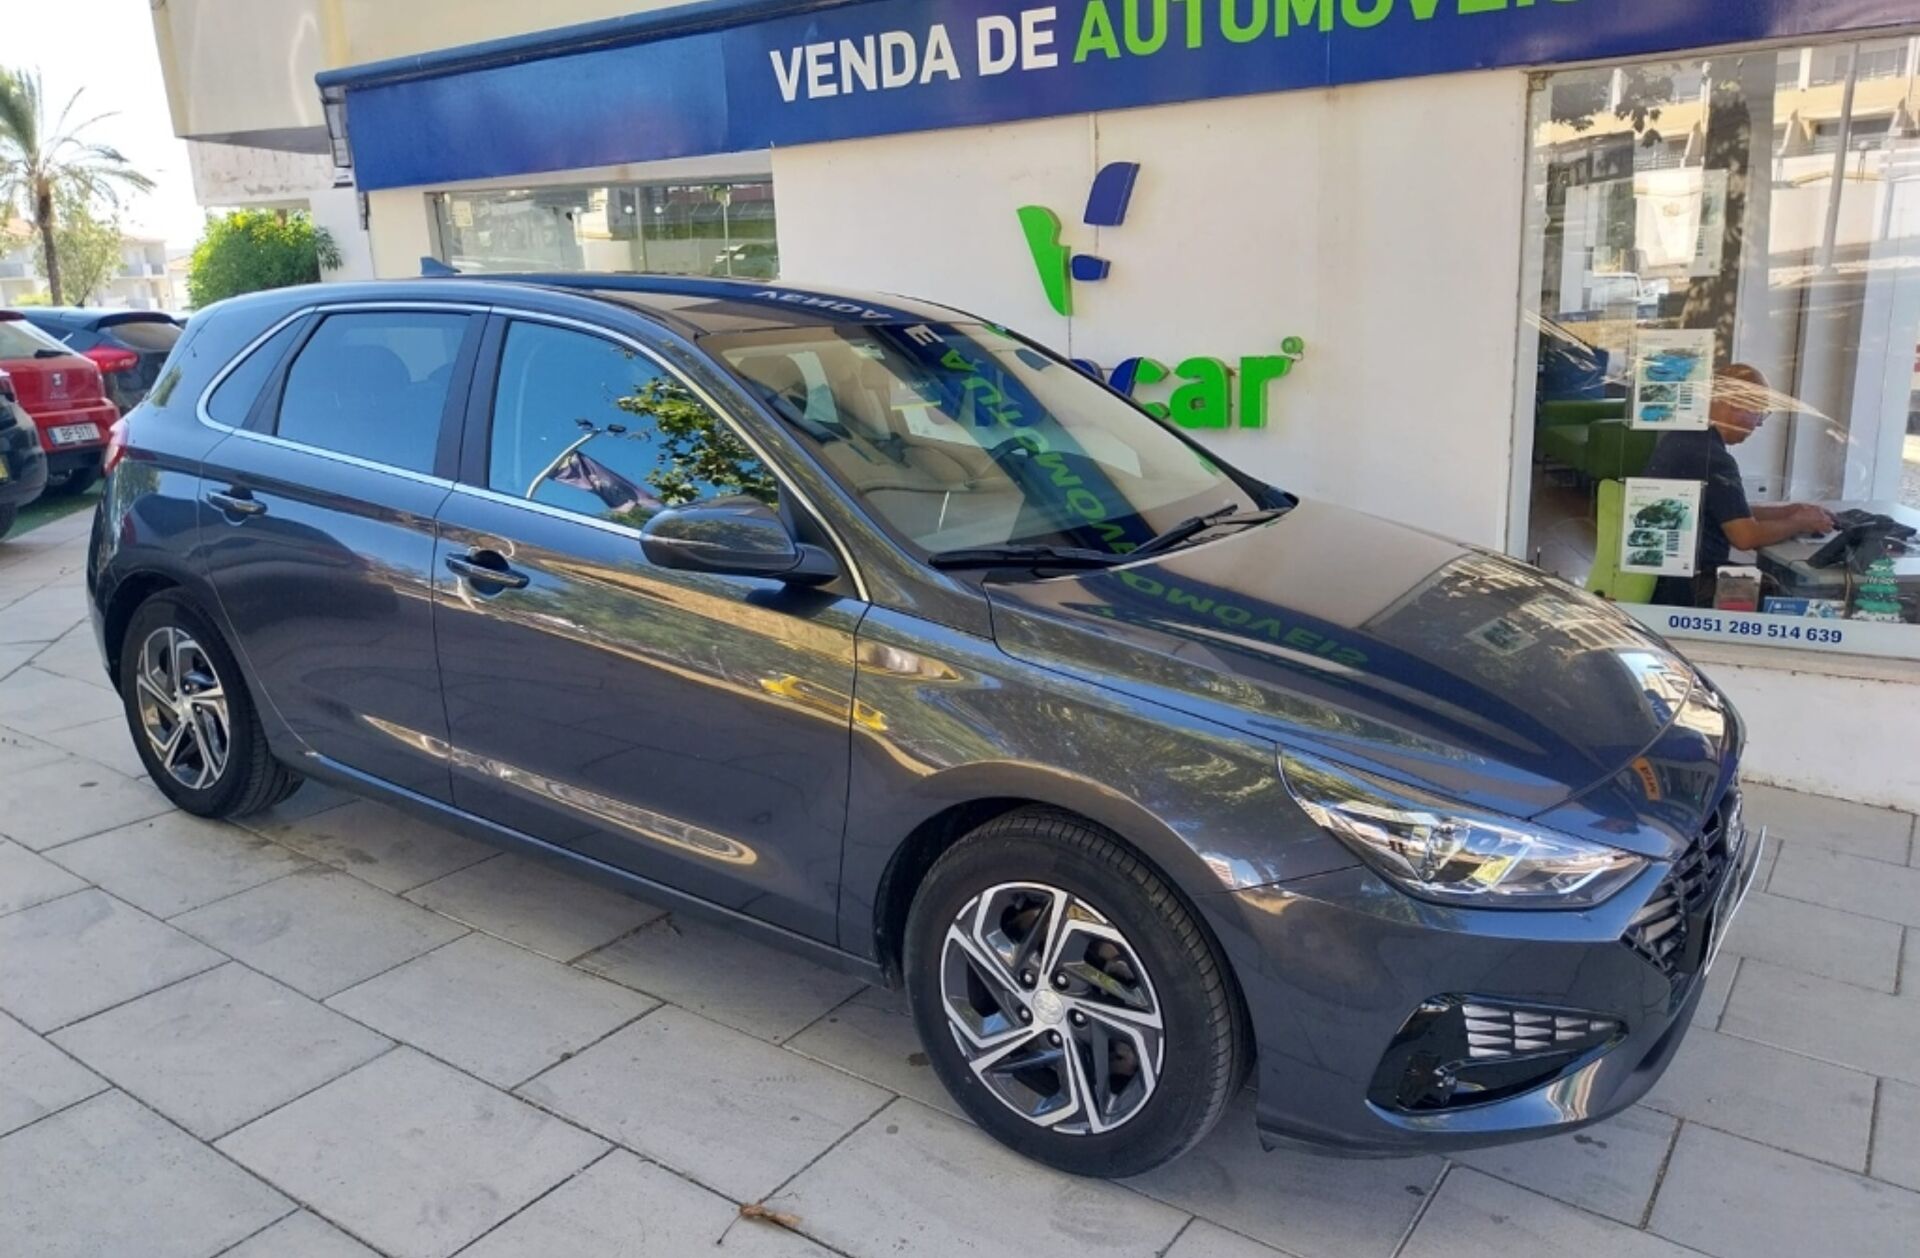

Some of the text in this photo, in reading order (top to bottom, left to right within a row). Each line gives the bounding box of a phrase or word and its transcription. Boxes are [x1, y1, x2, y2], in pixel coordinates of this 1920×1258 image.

[770, 24, 961, 102] VENDA
[977, 6, 1059, 76] DE
[1668, 615, 1842, 643] 00351 289 514 639
